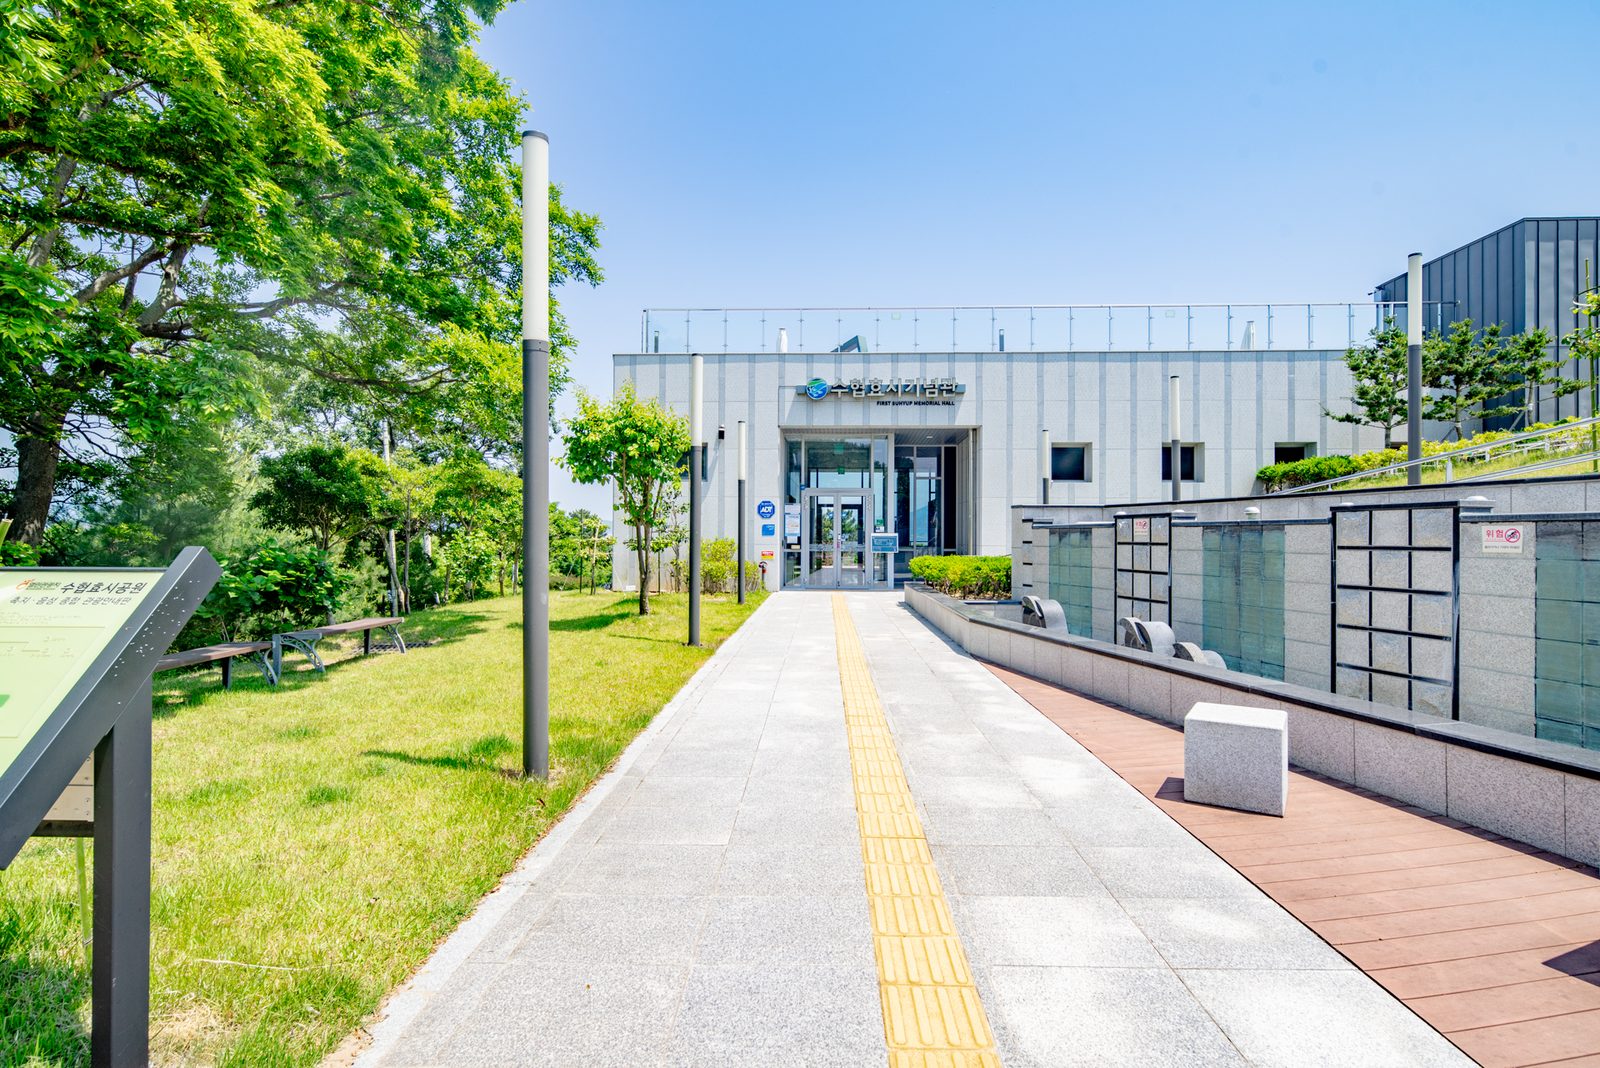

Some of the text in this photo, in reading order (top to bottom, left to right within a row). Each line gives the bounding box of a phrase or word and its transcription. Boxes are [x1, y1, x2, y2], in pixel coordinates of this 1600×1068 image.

[830, 378, 958, 398] 수협효시기념관
[1486, 530, 1504, 539] 위험
[61, 582, 148, 594] 수협효시공원
